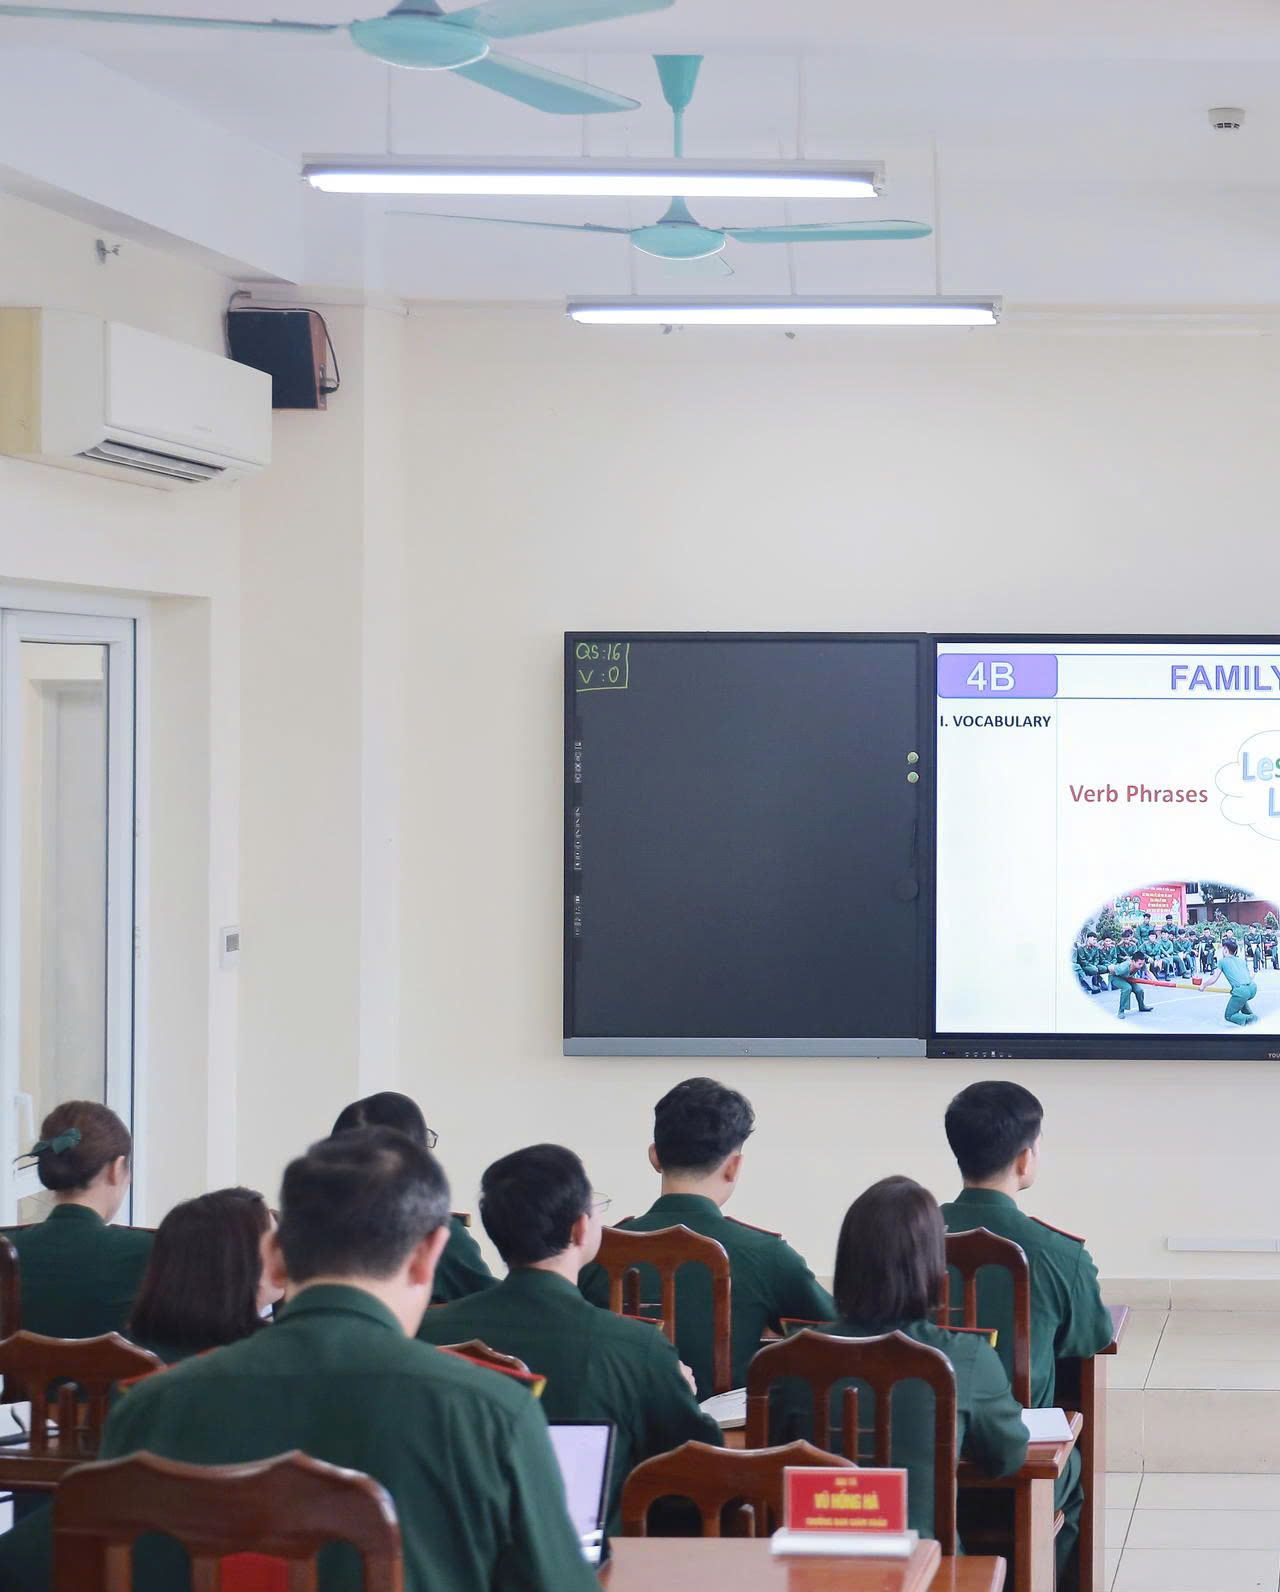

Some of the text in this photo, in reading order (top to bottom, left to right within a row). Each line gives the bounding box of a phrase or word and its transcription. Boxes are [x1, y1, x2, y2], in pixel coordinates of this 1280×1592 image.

[966, 661, 1016, 691] 4B
[953, 715, 1052, 728] VOCABULARY
[1069, 784, 1208, 803] Verb Phrases
